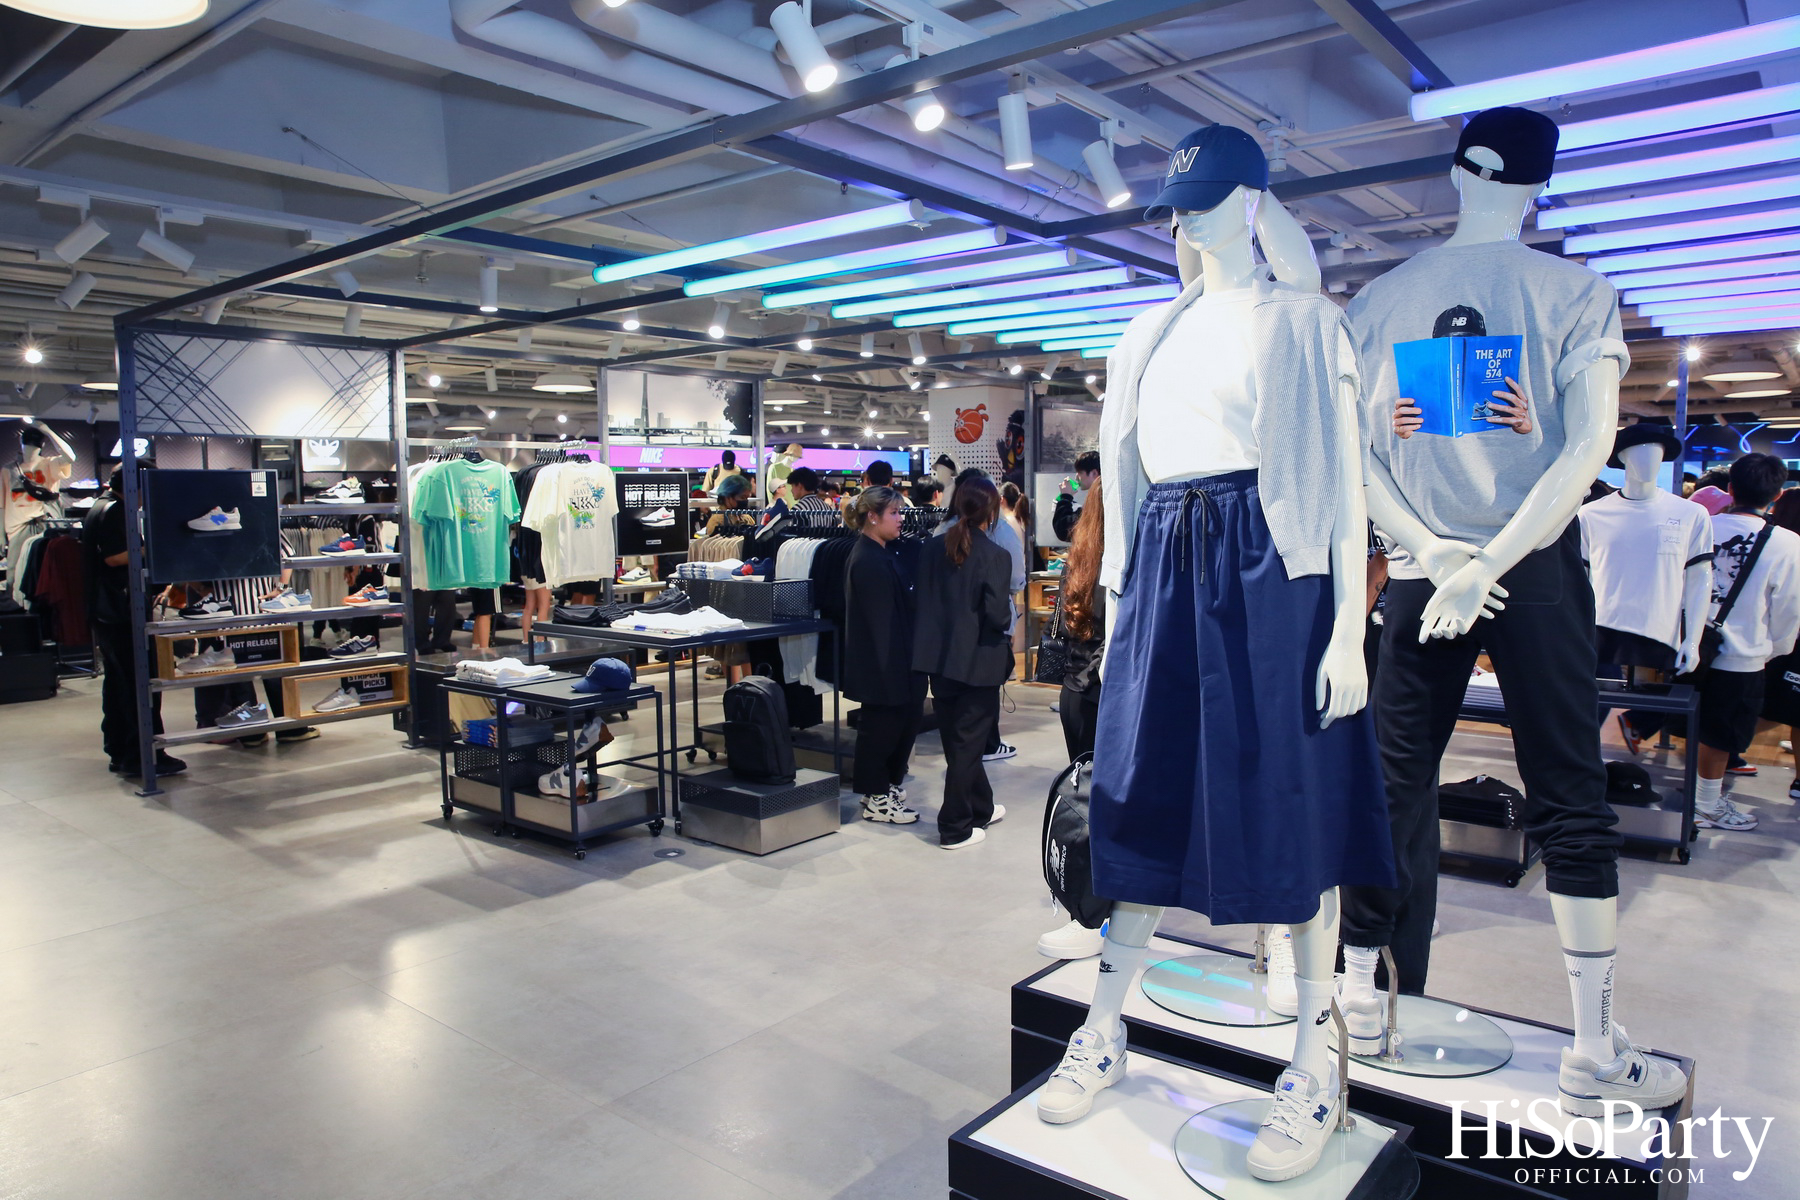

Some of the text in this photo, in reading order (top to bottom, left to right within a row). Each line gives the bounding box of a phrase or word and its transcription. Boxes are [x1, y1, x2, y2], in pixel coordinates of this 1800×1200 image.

[1451, 316, 1467, 327] NB
[1476, 348, 1512, 360] THE ART
[1488, 359, 1501, 369] OF
[1486, 369, 1502, 378] 574
[640, 448, 664, 464] NIKE
[625, 490, 680, 501] HOT RELEASE
[229, 638, 278, 649] HOT RELEASE
[364, 679, 385, 687] PICKS
[1785, 672, 1800, 683] Foo
[1601, 988, 1612, 1037] Balance
